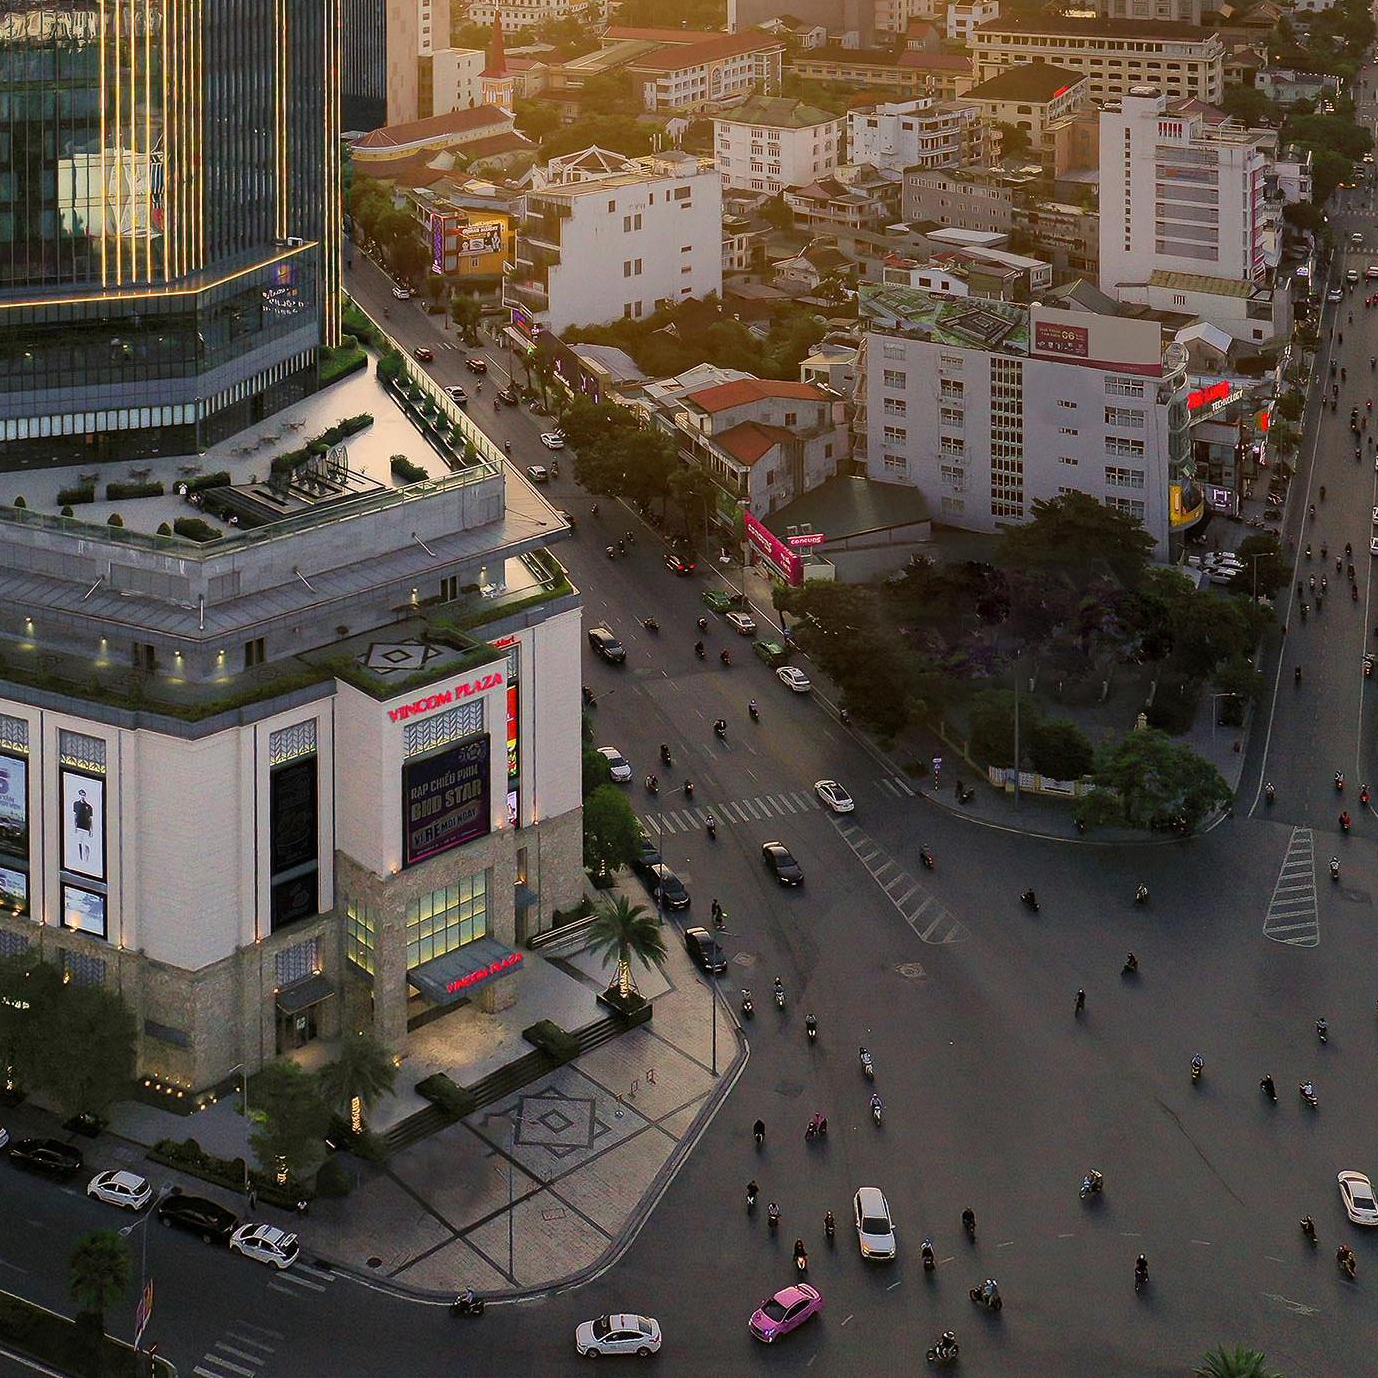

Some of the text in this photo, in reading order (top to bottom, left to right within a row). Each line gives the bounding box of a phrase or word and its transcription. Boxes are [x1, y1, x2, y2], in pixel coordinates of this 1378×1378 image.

[387, 672, 503, 723] VINCOM PLAZA
[445, 778, 482, 808] STAR
